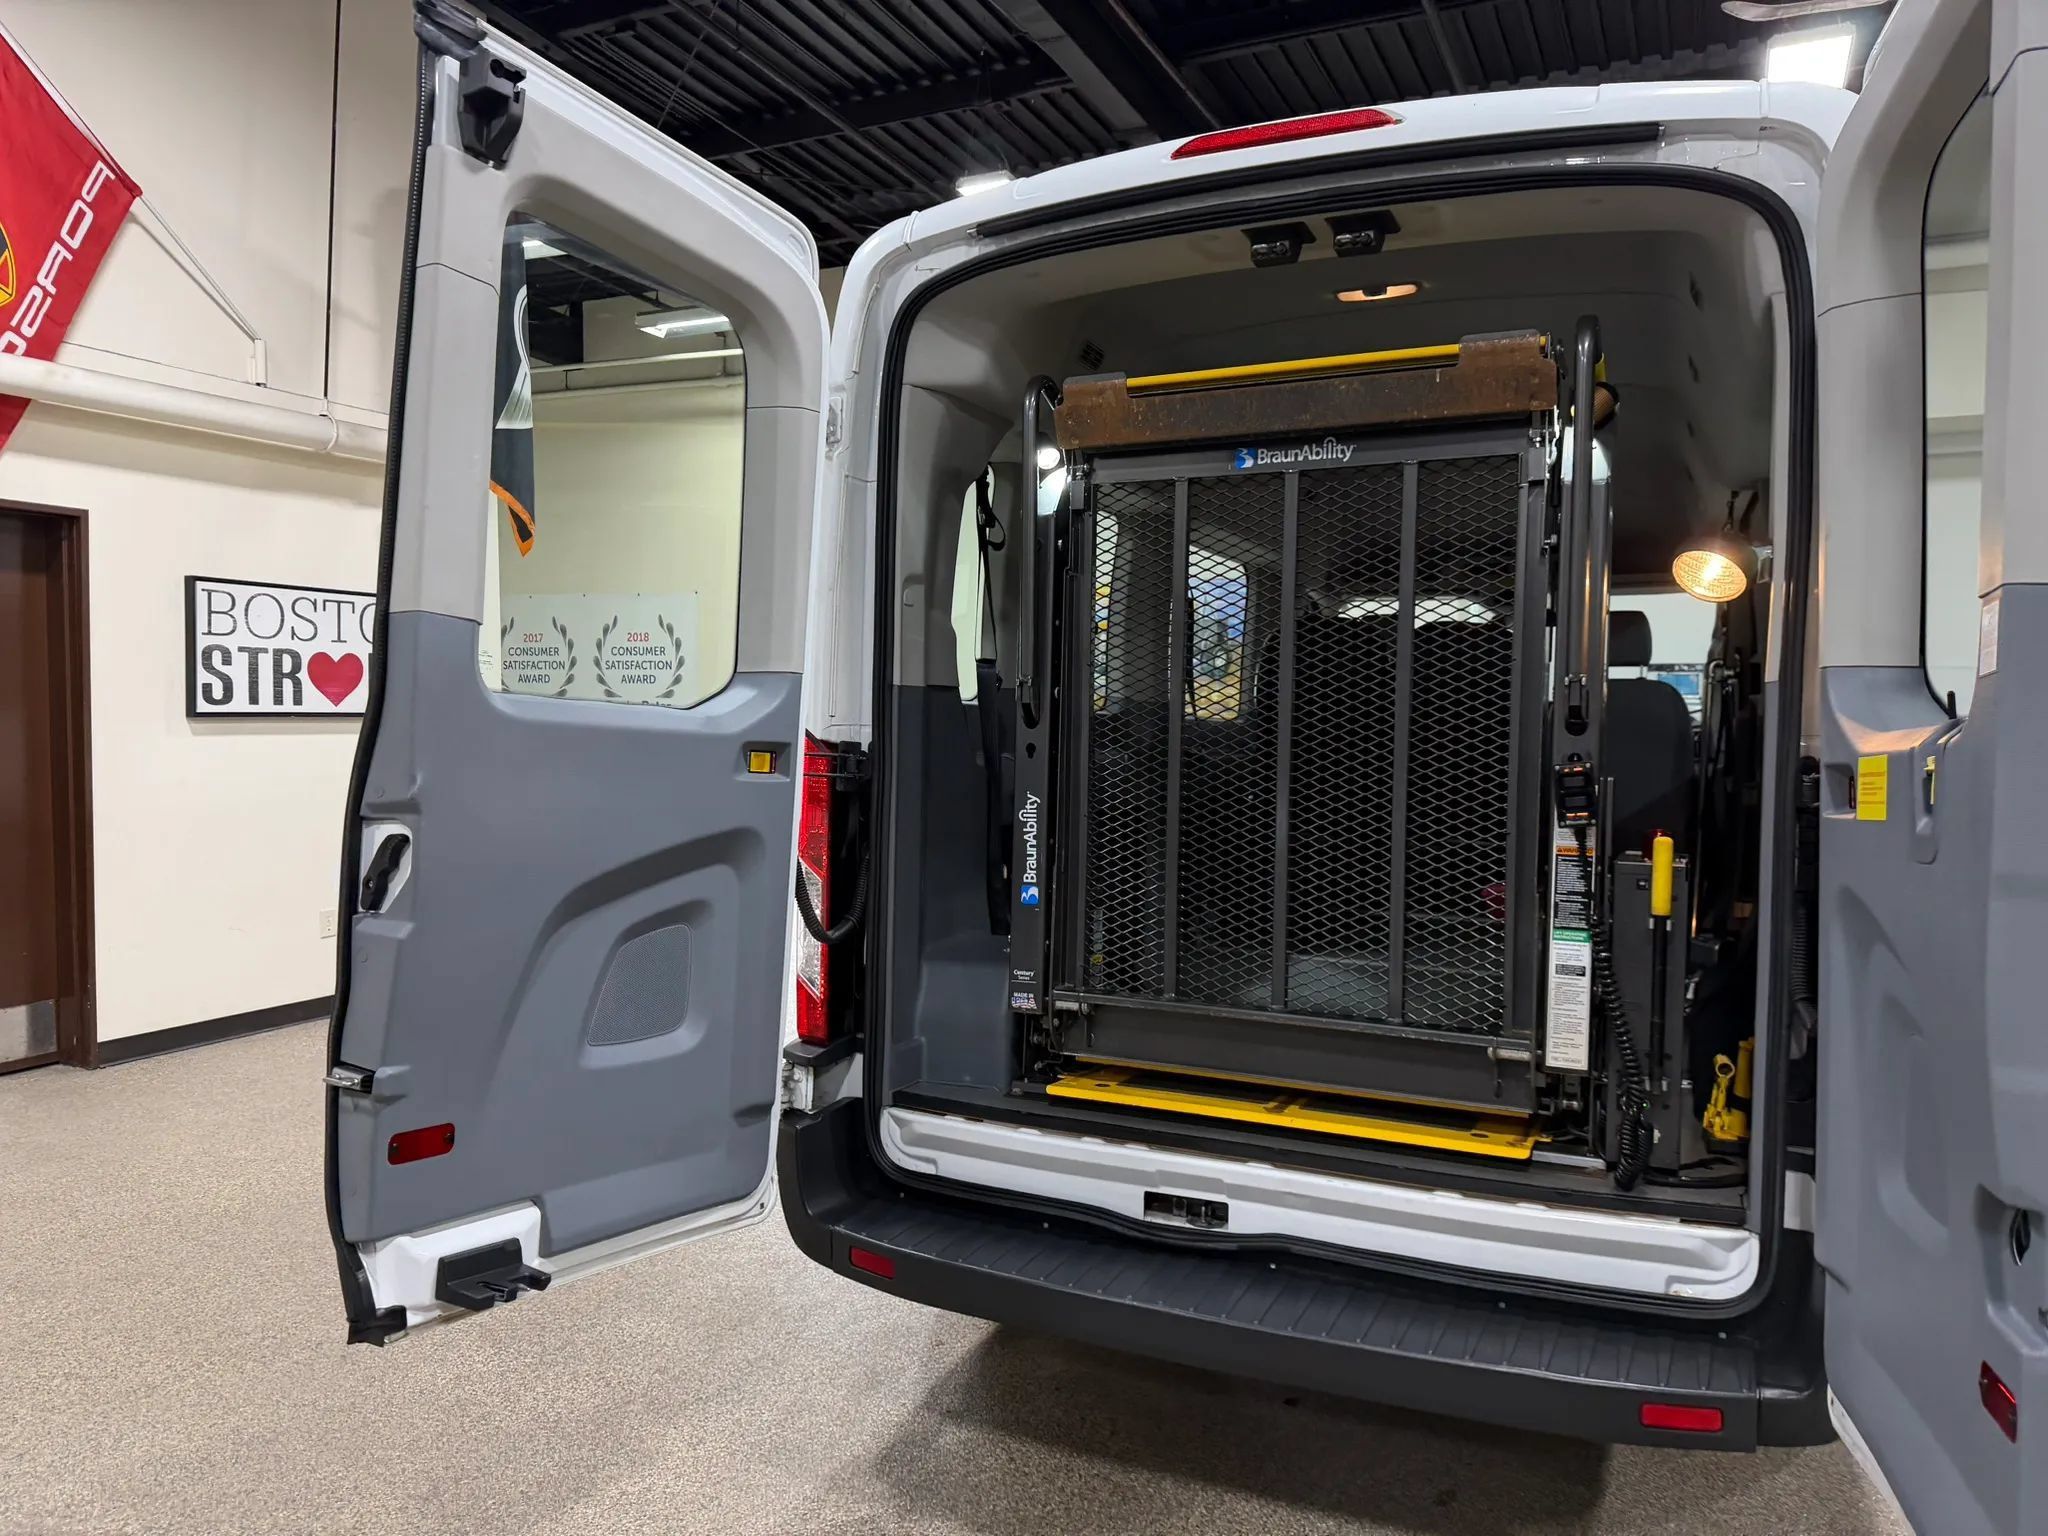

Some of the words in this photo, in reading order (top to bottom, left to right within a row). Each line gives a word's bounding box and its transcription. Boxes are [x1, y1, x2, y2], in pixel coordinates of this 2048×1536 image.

[1257, 437, 1355, 464] BraunAbility
[523, 633, 544, 643] 2017
[627, 632, 650, 642] 2018
[508, 646, 560, 657] CONSUMER
[611, 646, 666, 656] CONSUMER
[503, 660, 566, 670] SATISFACTION
[605, 660, 673, 670] SATISFACTION
[518, 674, 551, 684] AWARD
[621, 674, 656, 684] AWARD
[1019, 791, 1041, 883] BraunAbility
